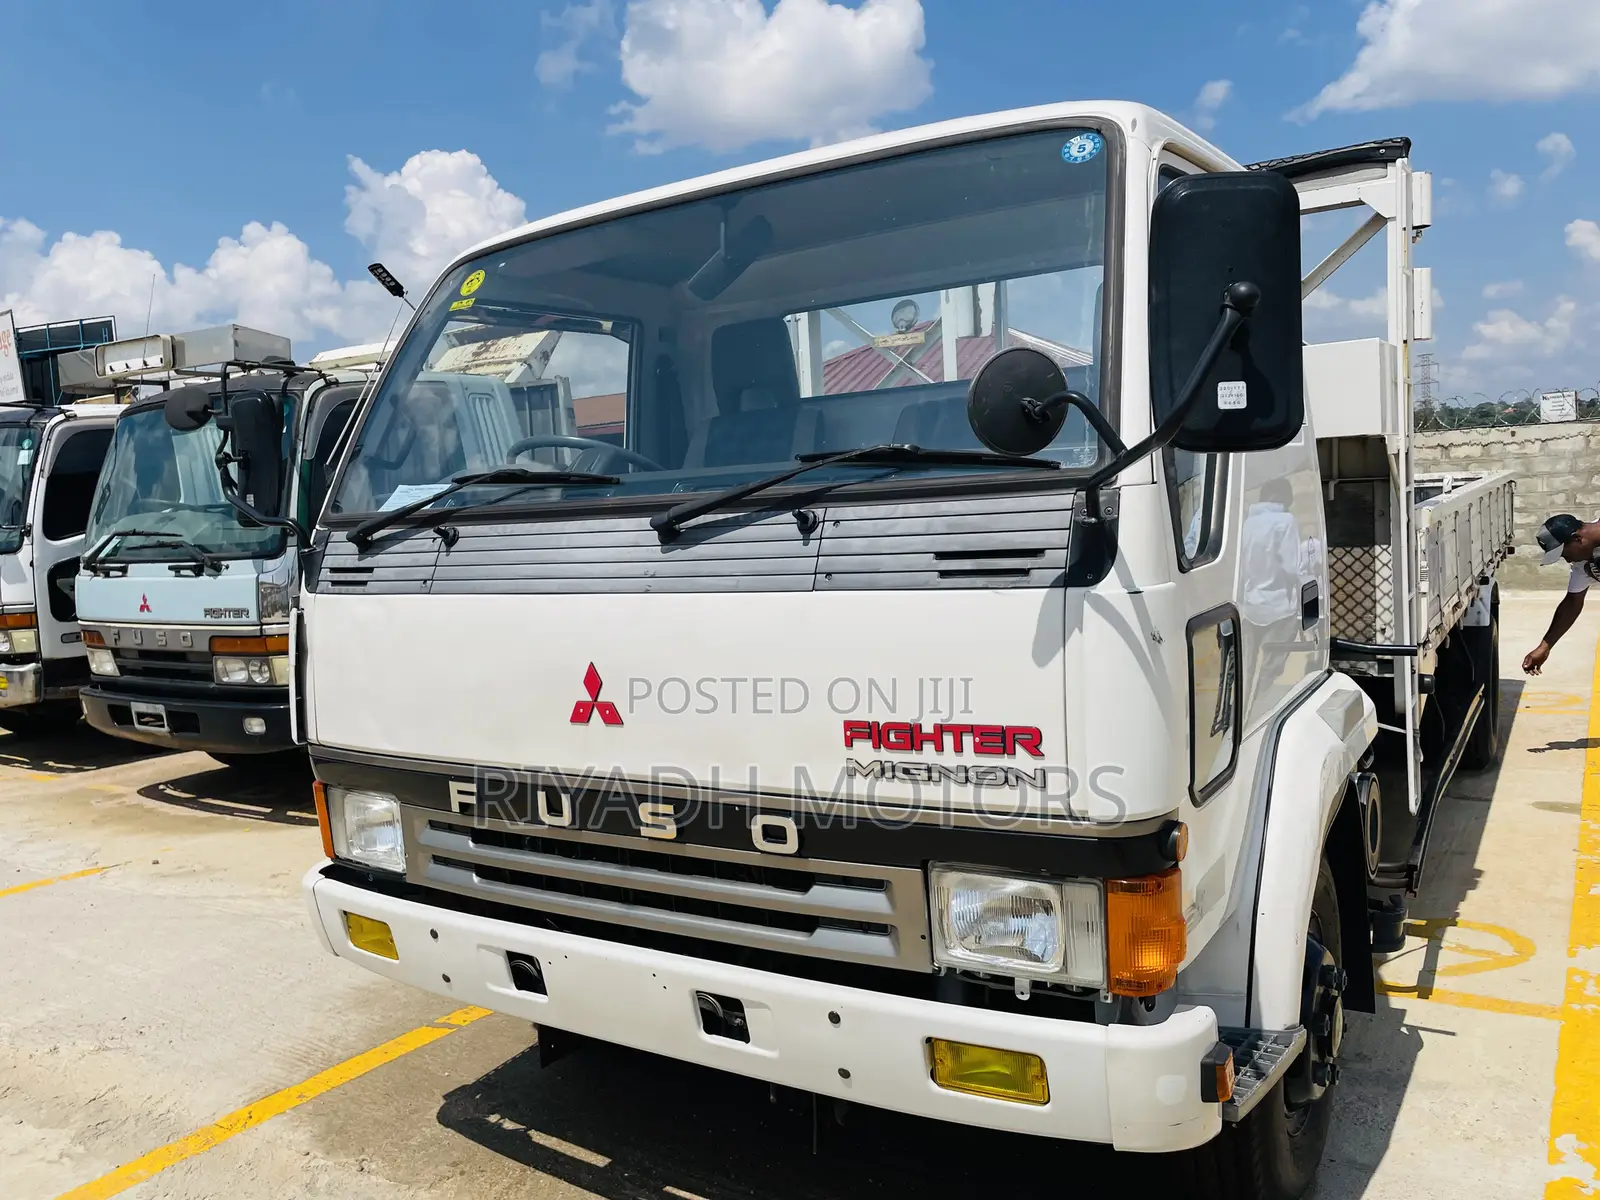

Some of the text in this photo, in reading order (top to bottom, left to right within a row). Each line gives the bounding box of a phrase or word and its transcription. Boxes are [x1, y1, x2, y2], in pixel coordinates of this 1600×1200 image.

[1076, 143, 1087, 154] 5
[203, 607, 250, 619] FIGHTER
[111, 628, 194, 648] FUSO
[843, 719, 1045, 758] FIGHTER
[846, 757, 1046, 790] MIGNON
[448, 779, 800, 855] FUSO
